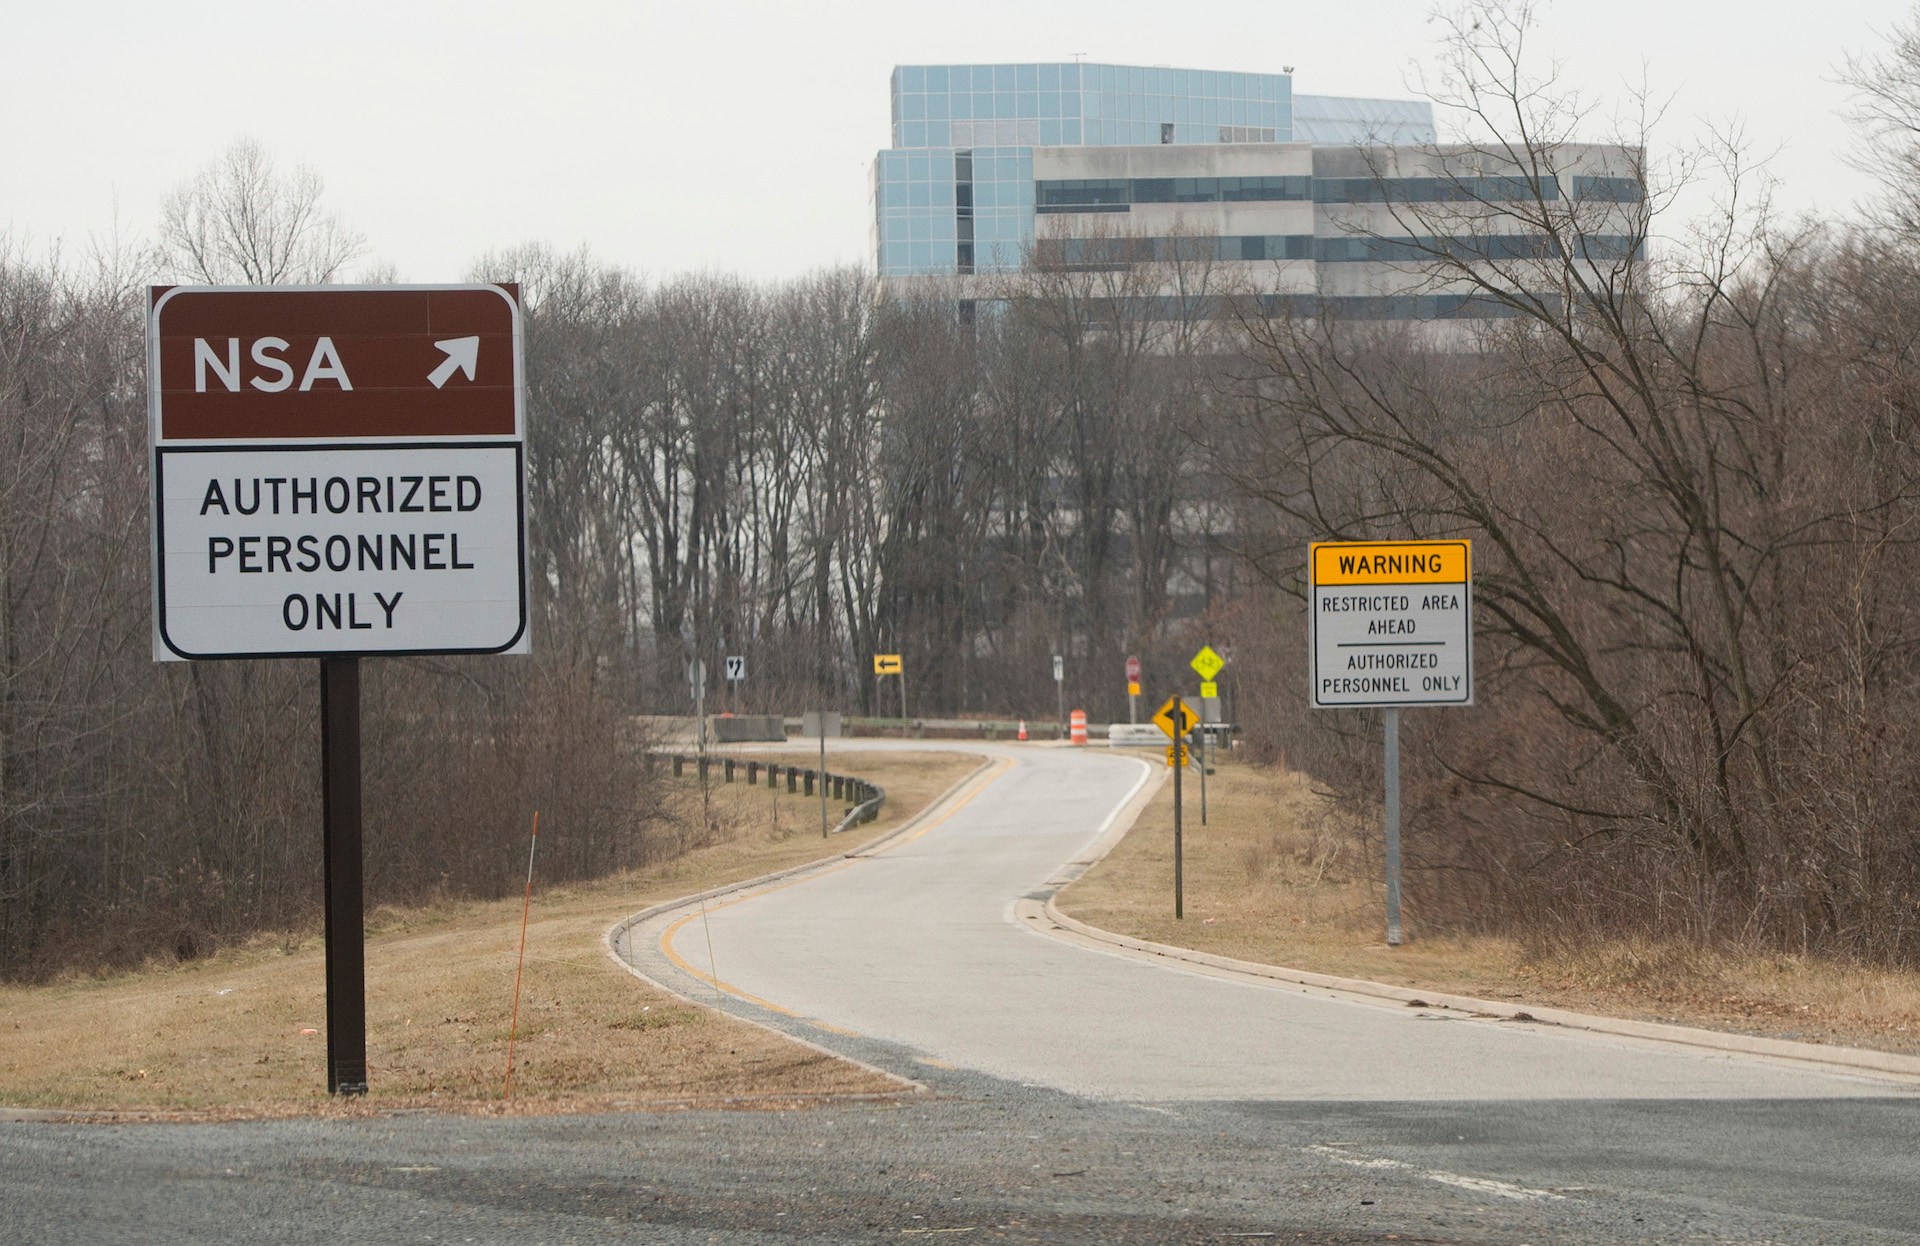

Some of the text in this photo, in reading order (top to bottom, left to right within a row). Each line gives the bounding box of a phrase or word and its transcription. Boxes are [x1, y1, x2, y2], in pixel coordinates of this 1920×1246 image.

[194, 336, 354, 393] NSA
[200, 475, 482, 515] AUTHORIZED
[208, 533, 474, 573] PERSONNEL
[1339, 554, 1442, 575] WARNING
[283, 592, 403, 632] ONLY
[1322, 595, 1459, 612] RESTRICTED AREA
[1368, 619, 1416, 634] AHEAD
[1347, 653, 1438, 670] AUTHORIZED
[1323, 676, 1460, 693] PERSONNEL ONLY
